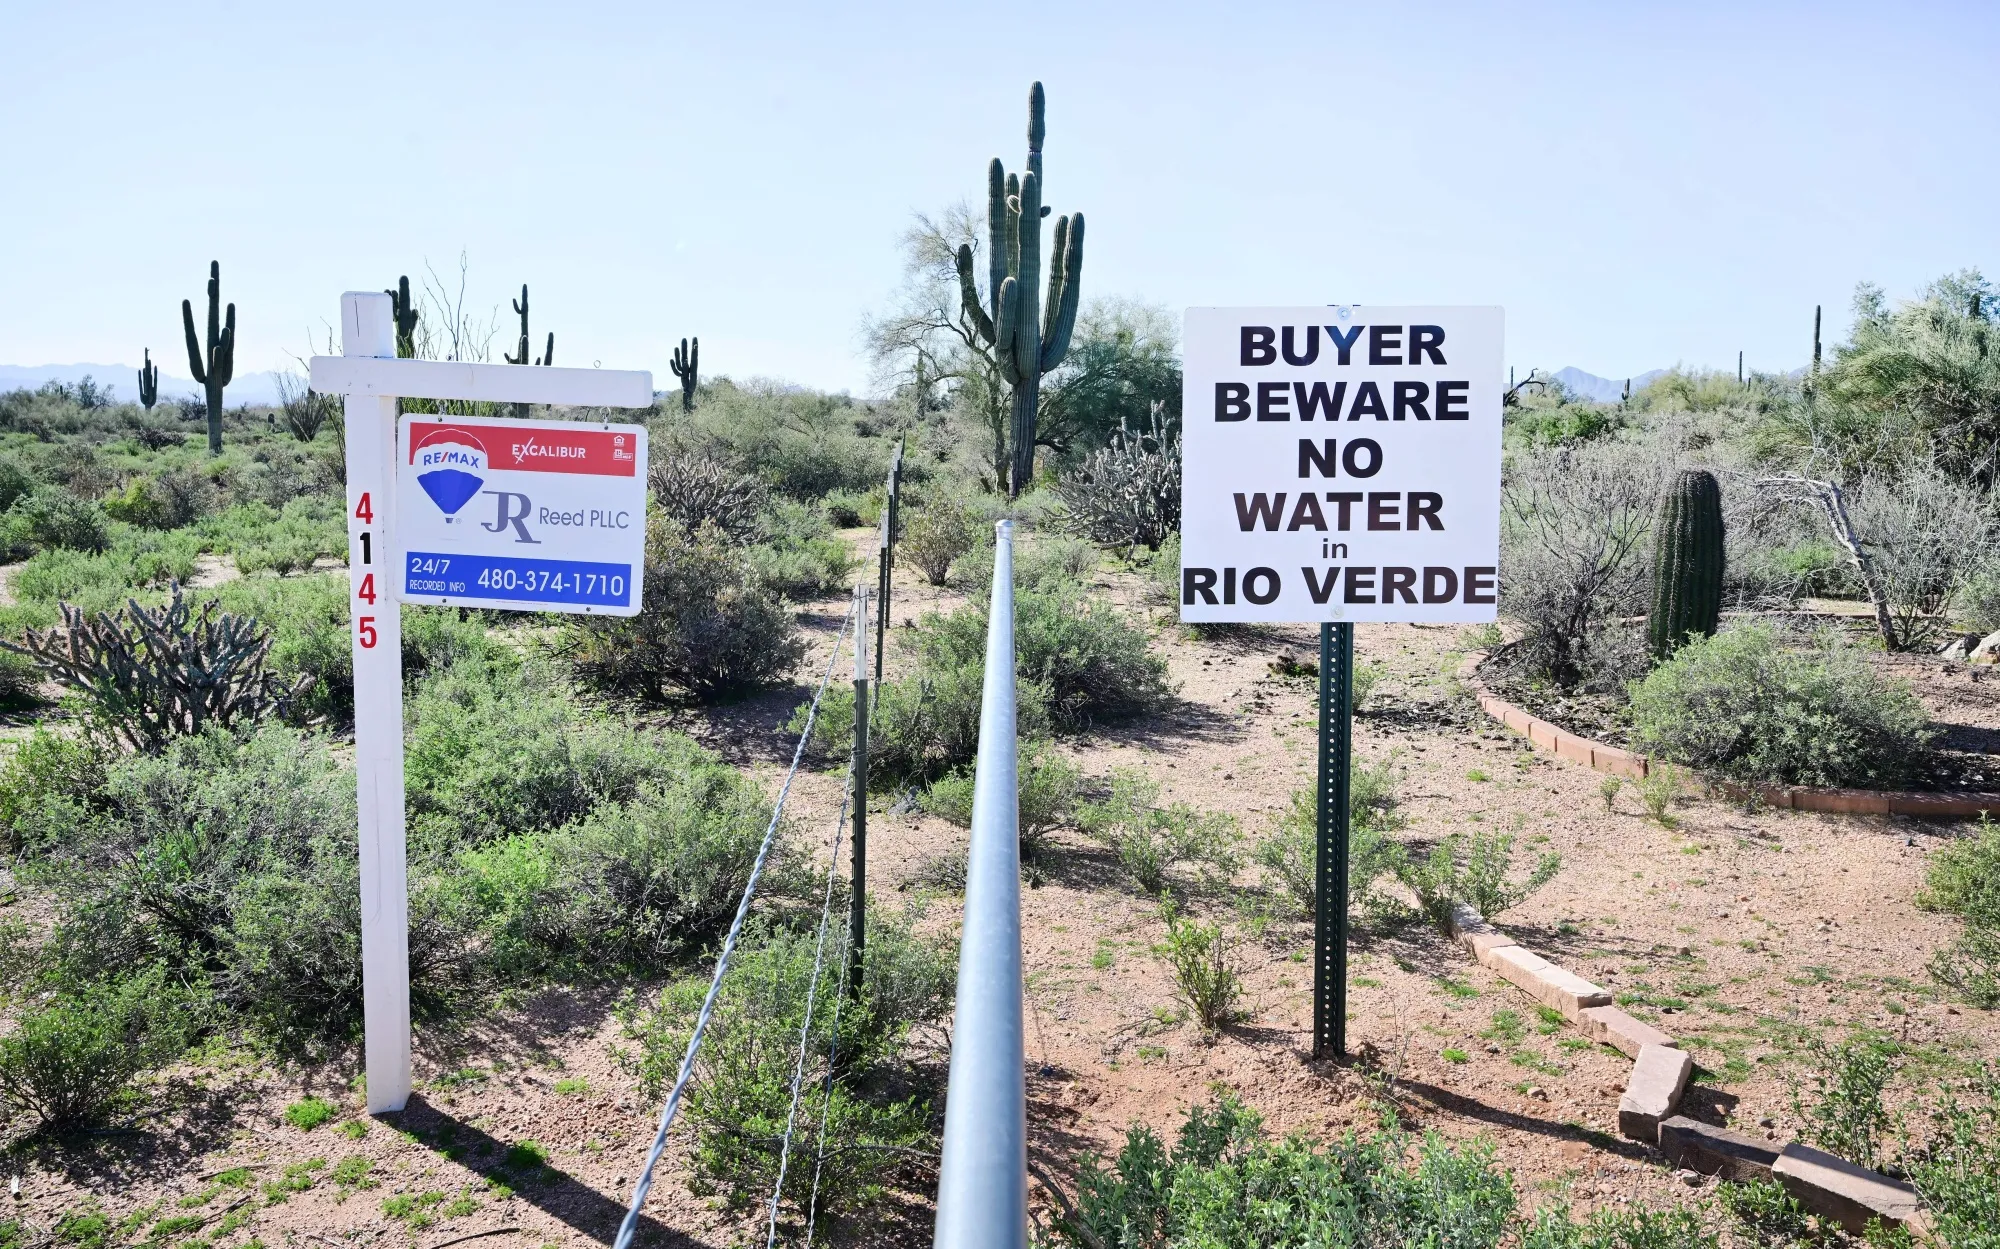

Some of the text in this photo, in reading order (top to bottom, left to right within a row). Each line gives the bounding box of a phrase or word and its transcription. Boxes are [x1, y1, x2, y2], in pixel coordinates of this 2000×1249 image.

[1240, 325, 1448, 366] BUYER
[1214, 380, 1470, 422] BEWARE
[423, 452, 479, 469] RE/MAX
[512, 437, 586, 464] EXCALIBUR
[1298, 438, 1383, 479] NO
[539, 507, 584, 527] Reed
[590, 510, 629, 529] PLLC
[1233, 491, 1445, 532] WATER
[1322, 538, 1348, 559] in
[411, 558, 450, 575] 24/7
[409, 580, 465, 593] RECORDED INFO
[477, 569, 624, 597] 480-374-1710
[1183, 566, 1496, 605] RIO VERDE
